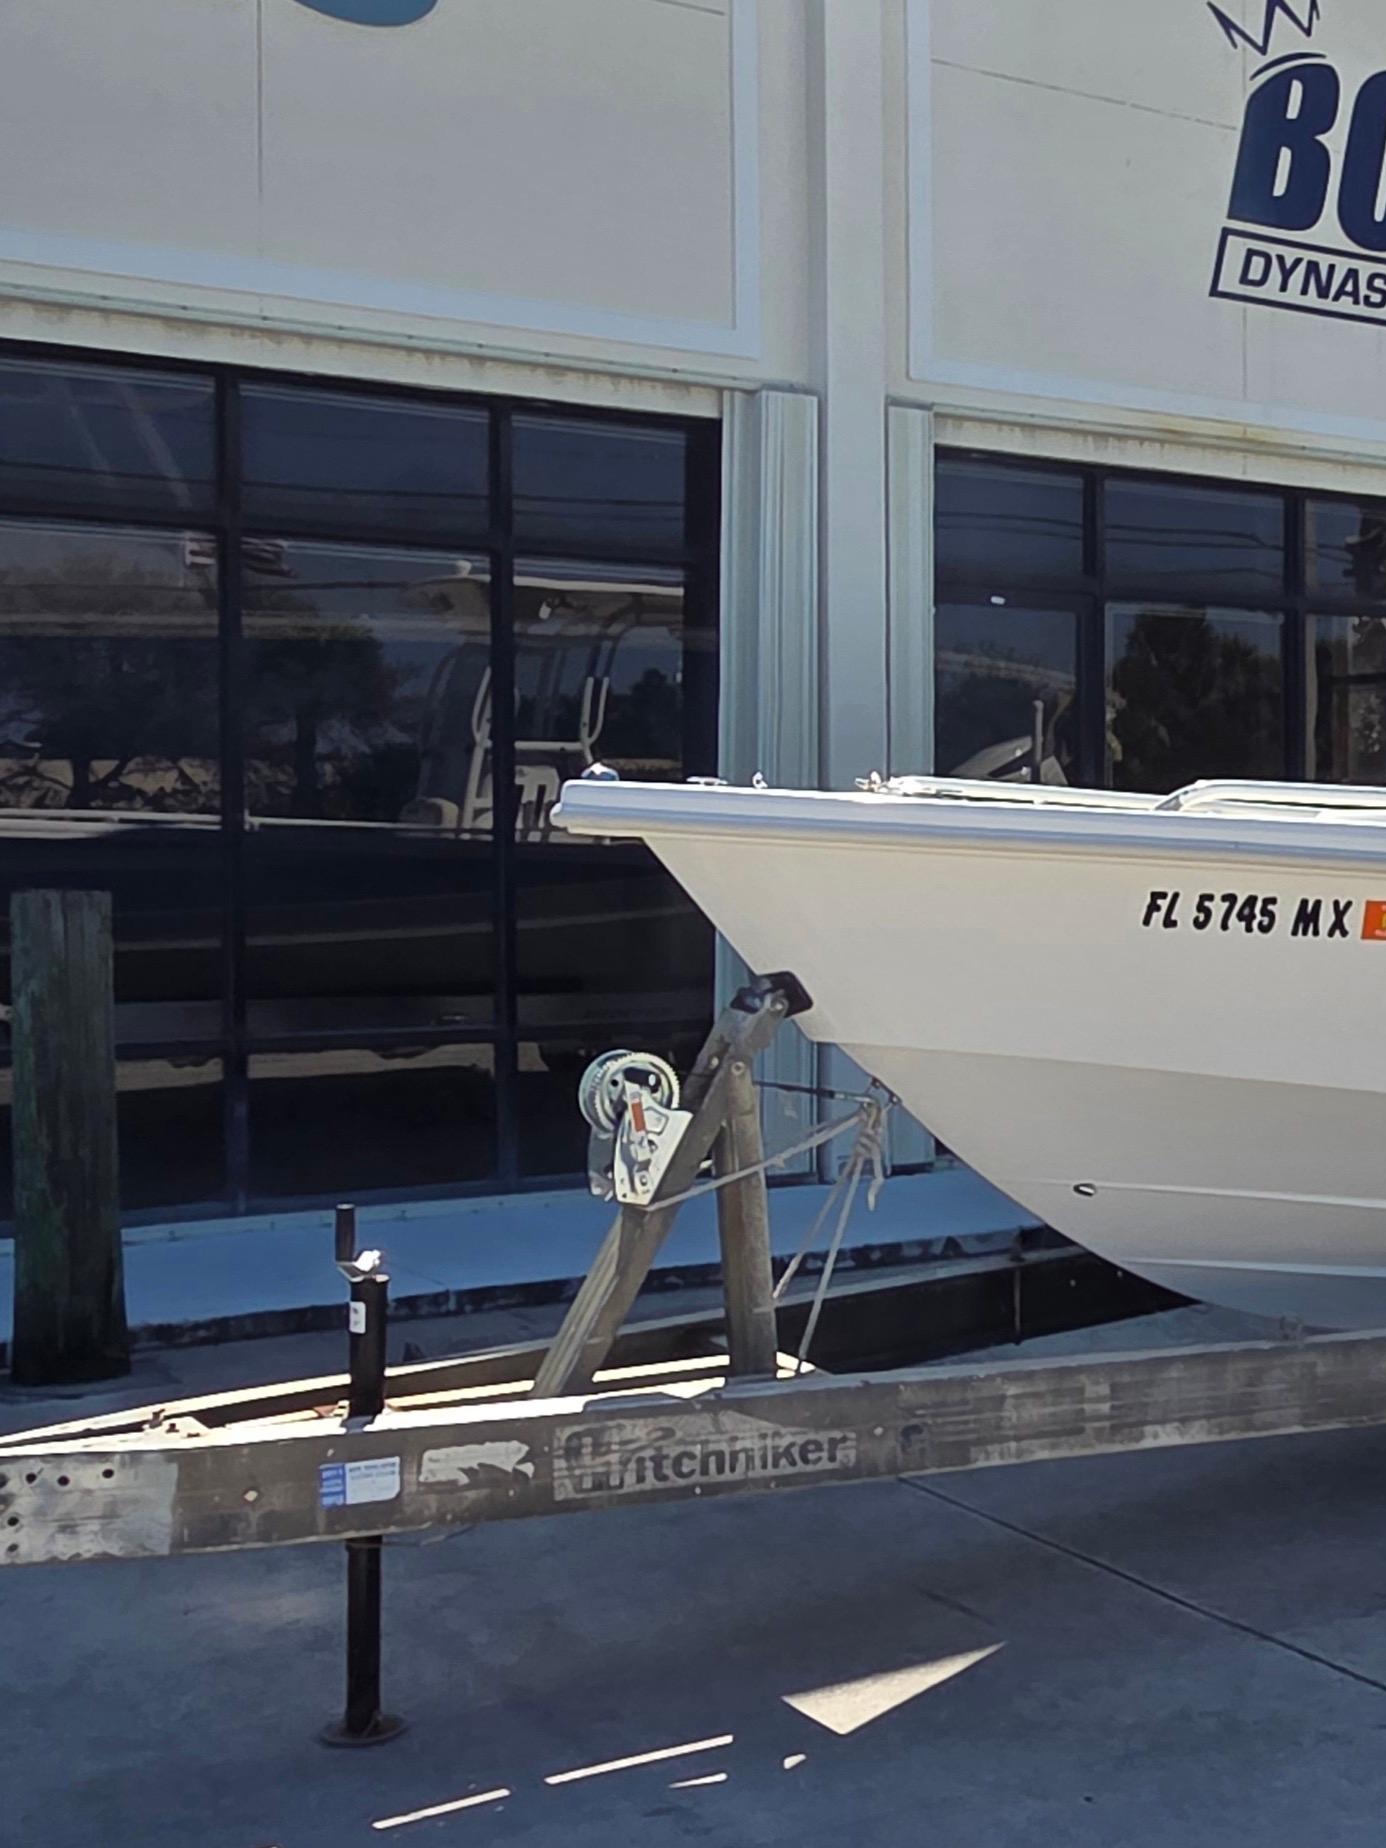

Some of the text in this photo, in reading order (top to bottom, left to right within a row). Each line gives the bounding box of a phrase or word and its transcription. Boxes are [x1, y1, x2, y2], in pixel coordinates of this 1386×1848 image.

[1142, 891, 1353, 938] FL 5745 MX
